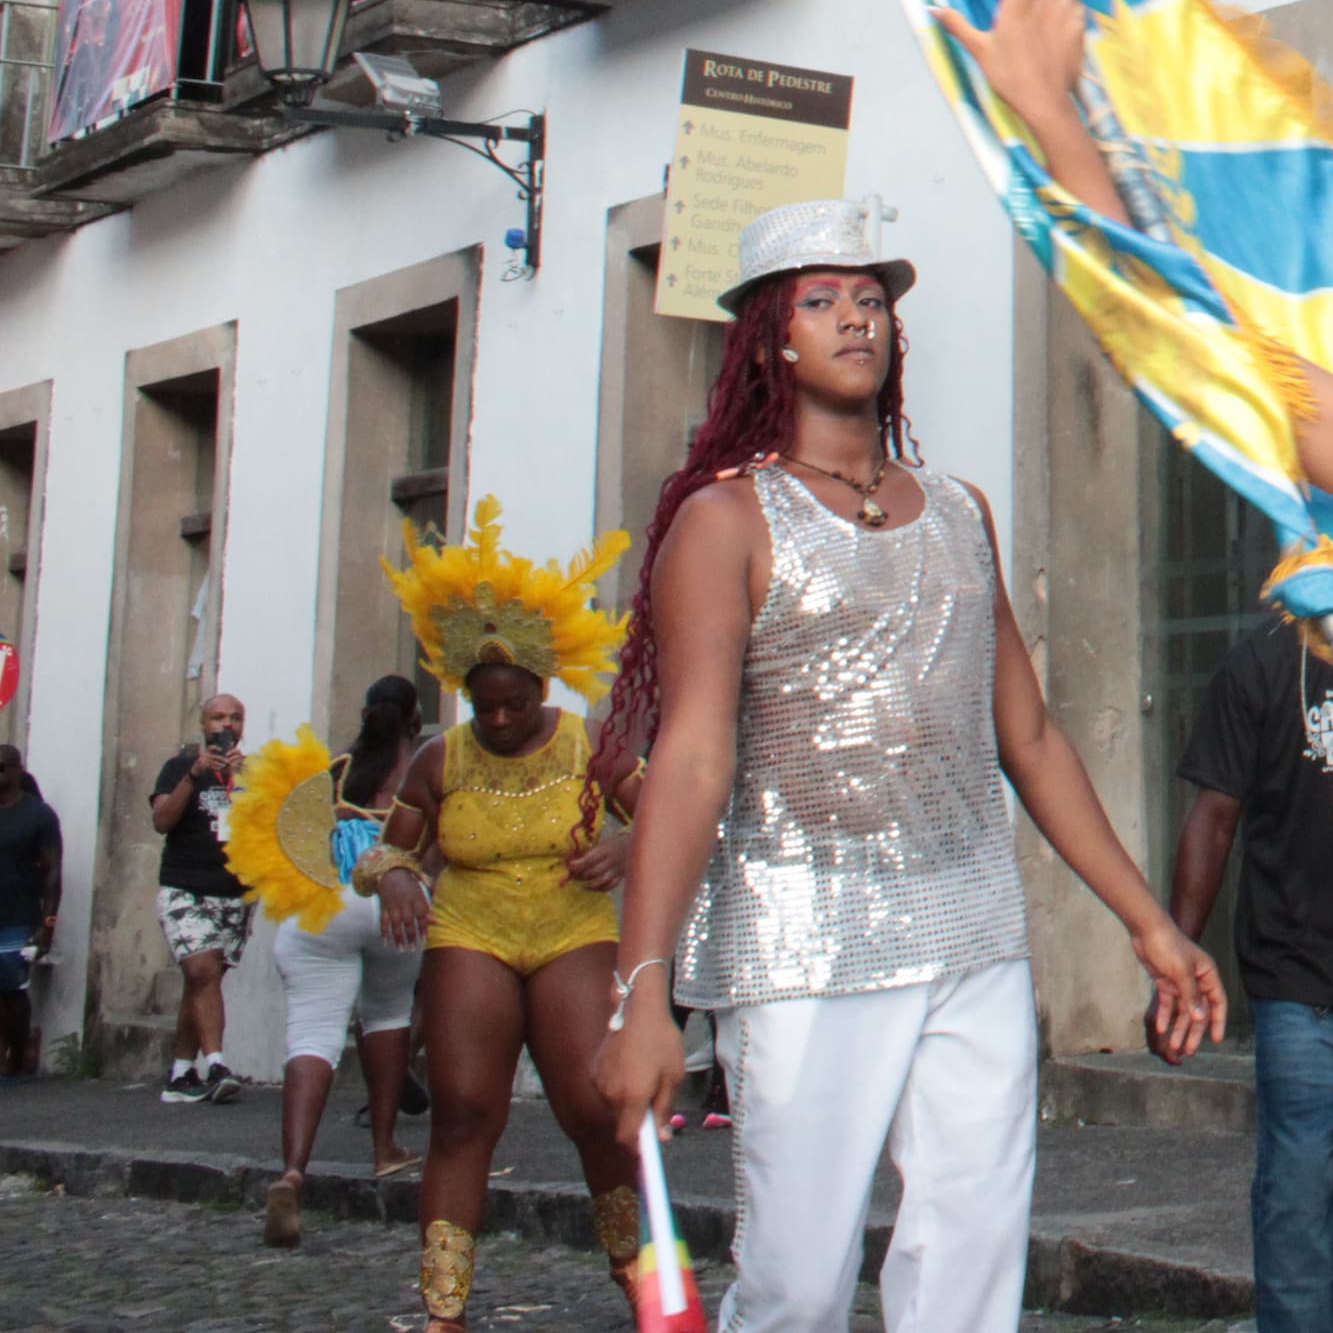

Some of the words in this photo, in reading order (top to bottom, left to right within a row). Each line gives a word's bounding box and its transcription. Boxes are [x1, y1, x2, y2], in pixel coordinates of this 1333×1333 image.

[703, 59, 744, 79] ROTA
[747, 68, 766, 83] DE
[766, 69, 833, 95] PEDESTRE
[738, 129, 828, 156] Enfermagem
[736, 154, 800, 179] Abelardo
[695, 167, 765, 192] Rodrigues
[692, 192, 729, 214] Sede
[685, 263, 721, 284] Forte
